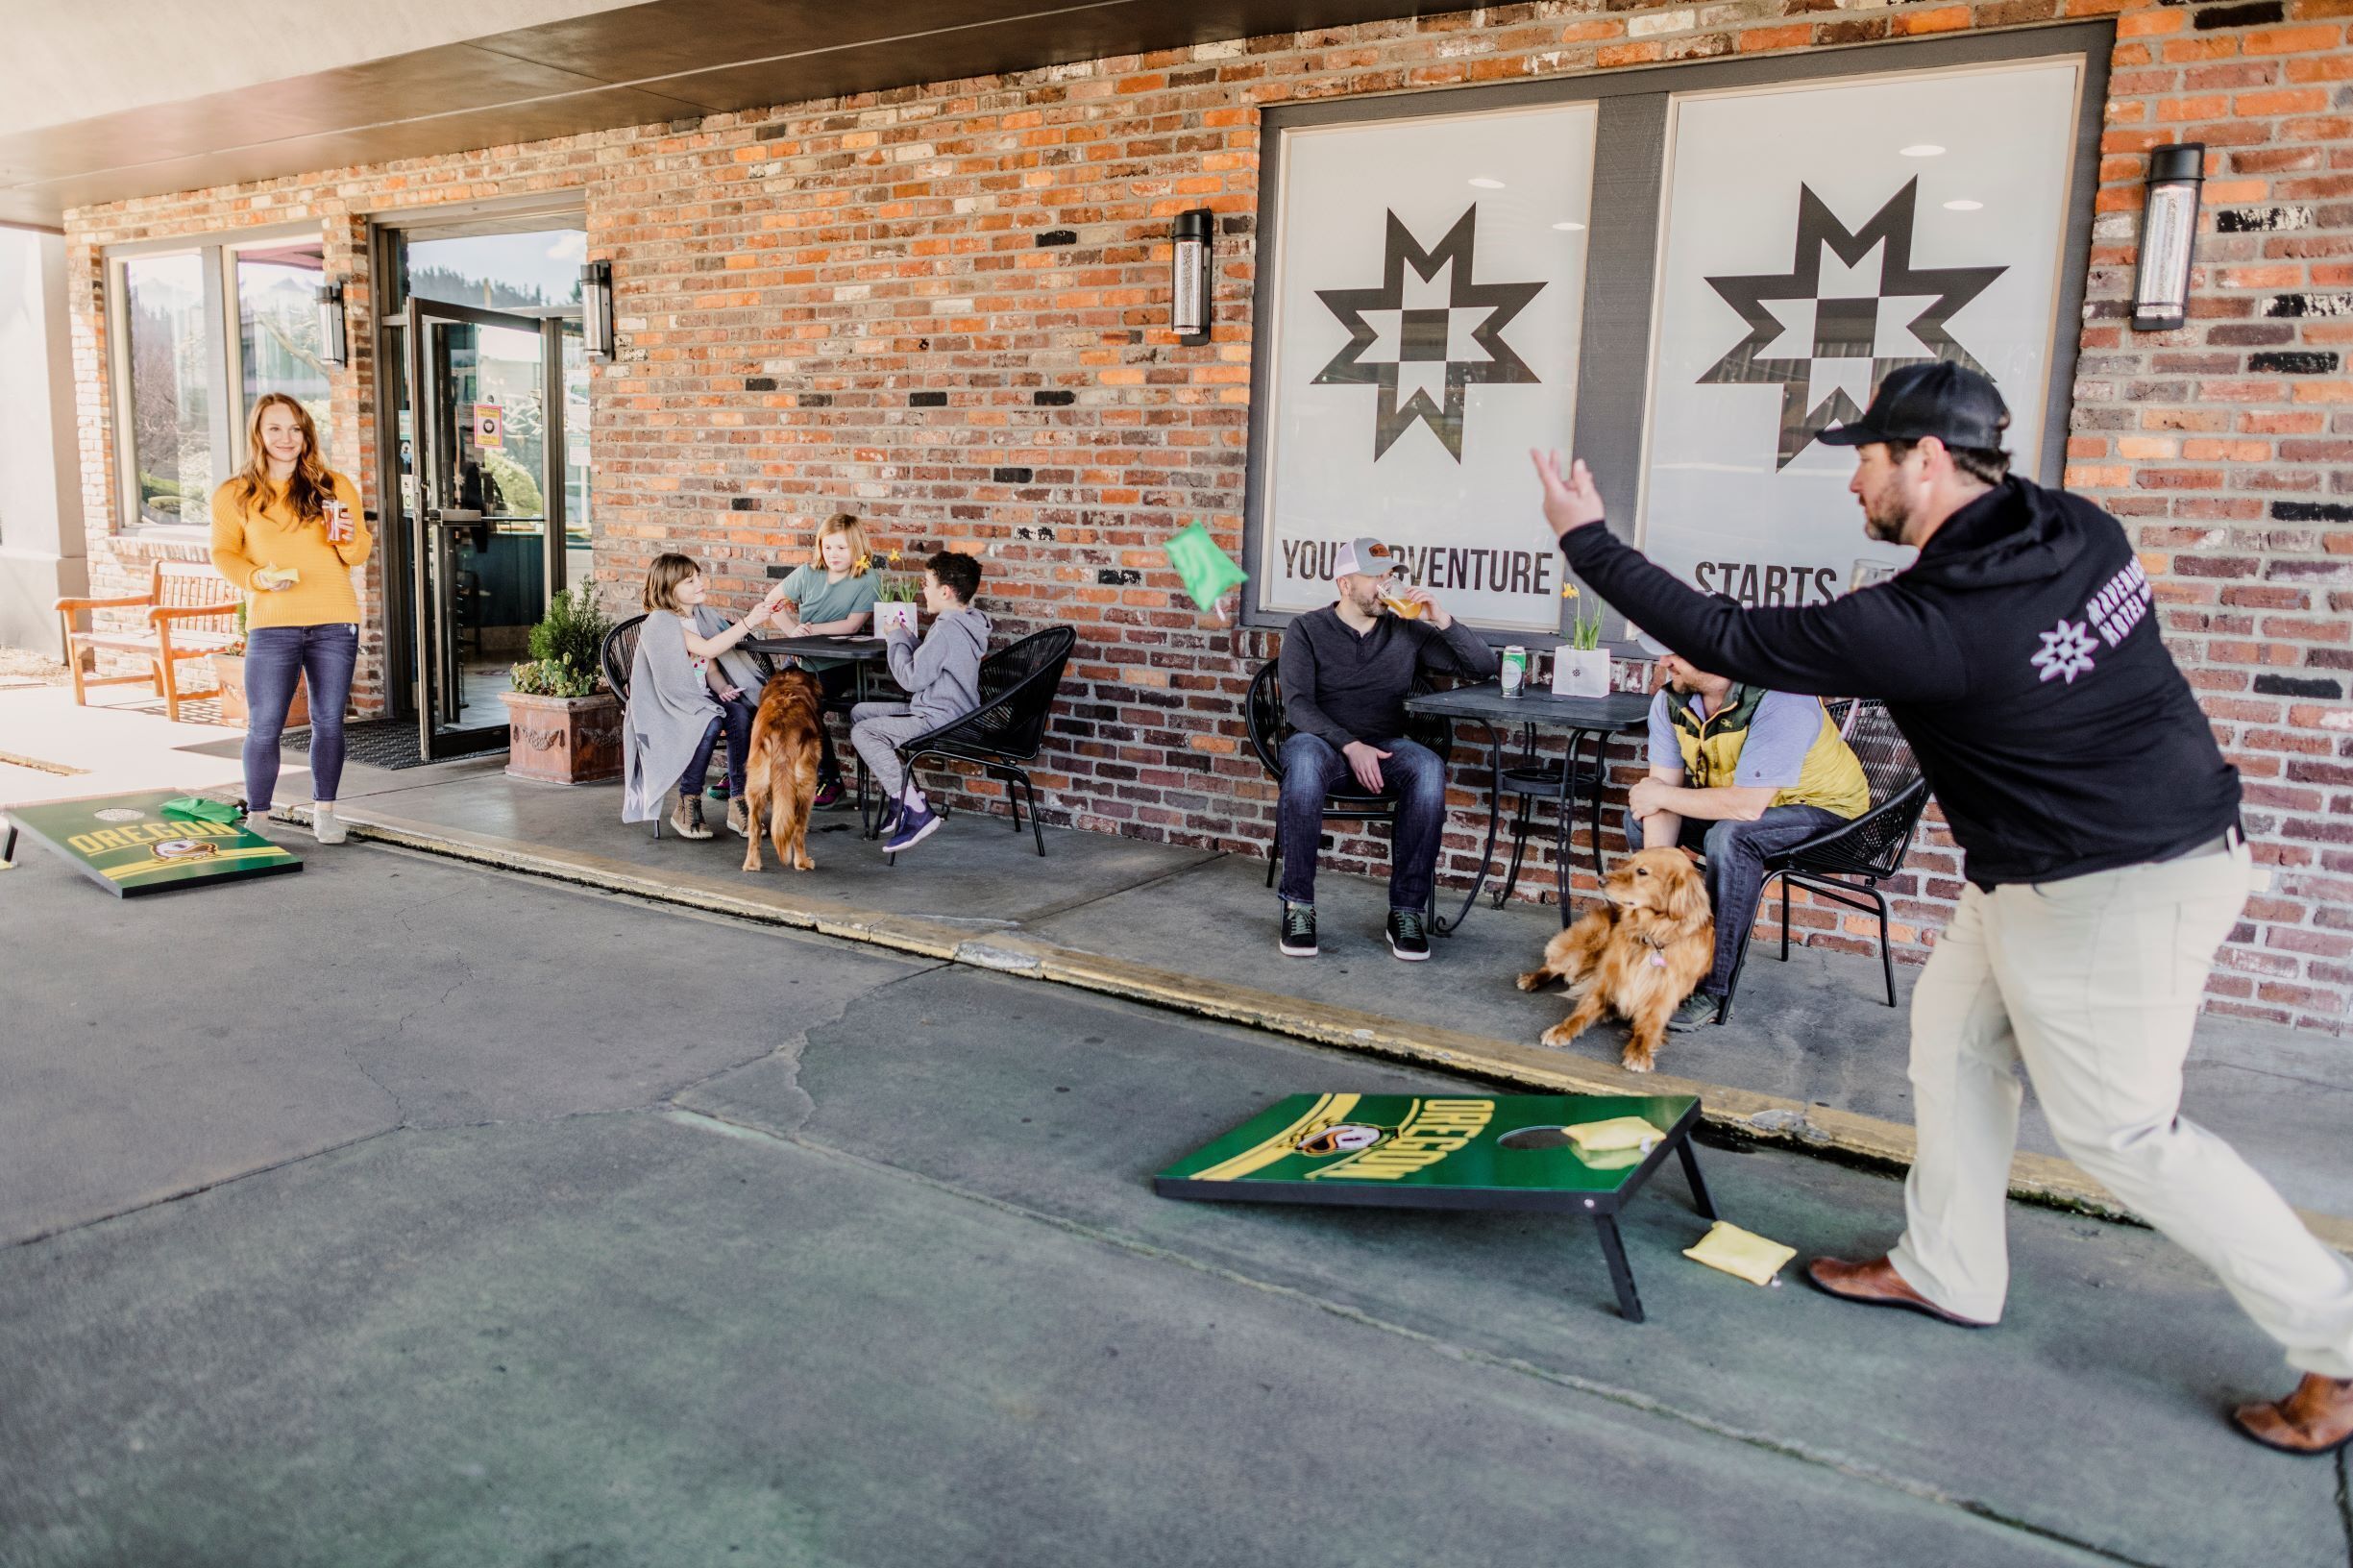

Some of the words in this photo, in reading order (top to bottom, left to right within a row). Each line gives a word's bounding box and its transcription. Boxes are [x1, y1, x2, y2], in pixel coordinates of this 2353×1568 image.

[1282, 538, 1348, 581] YOU
[1387, 543, 1554, 596] DVENTURE
[1694, 560, 1838, 608] STARTS
[67, 820, 241, 854] OREGON
[1321, 1099, 1496, 1180] OREGON
